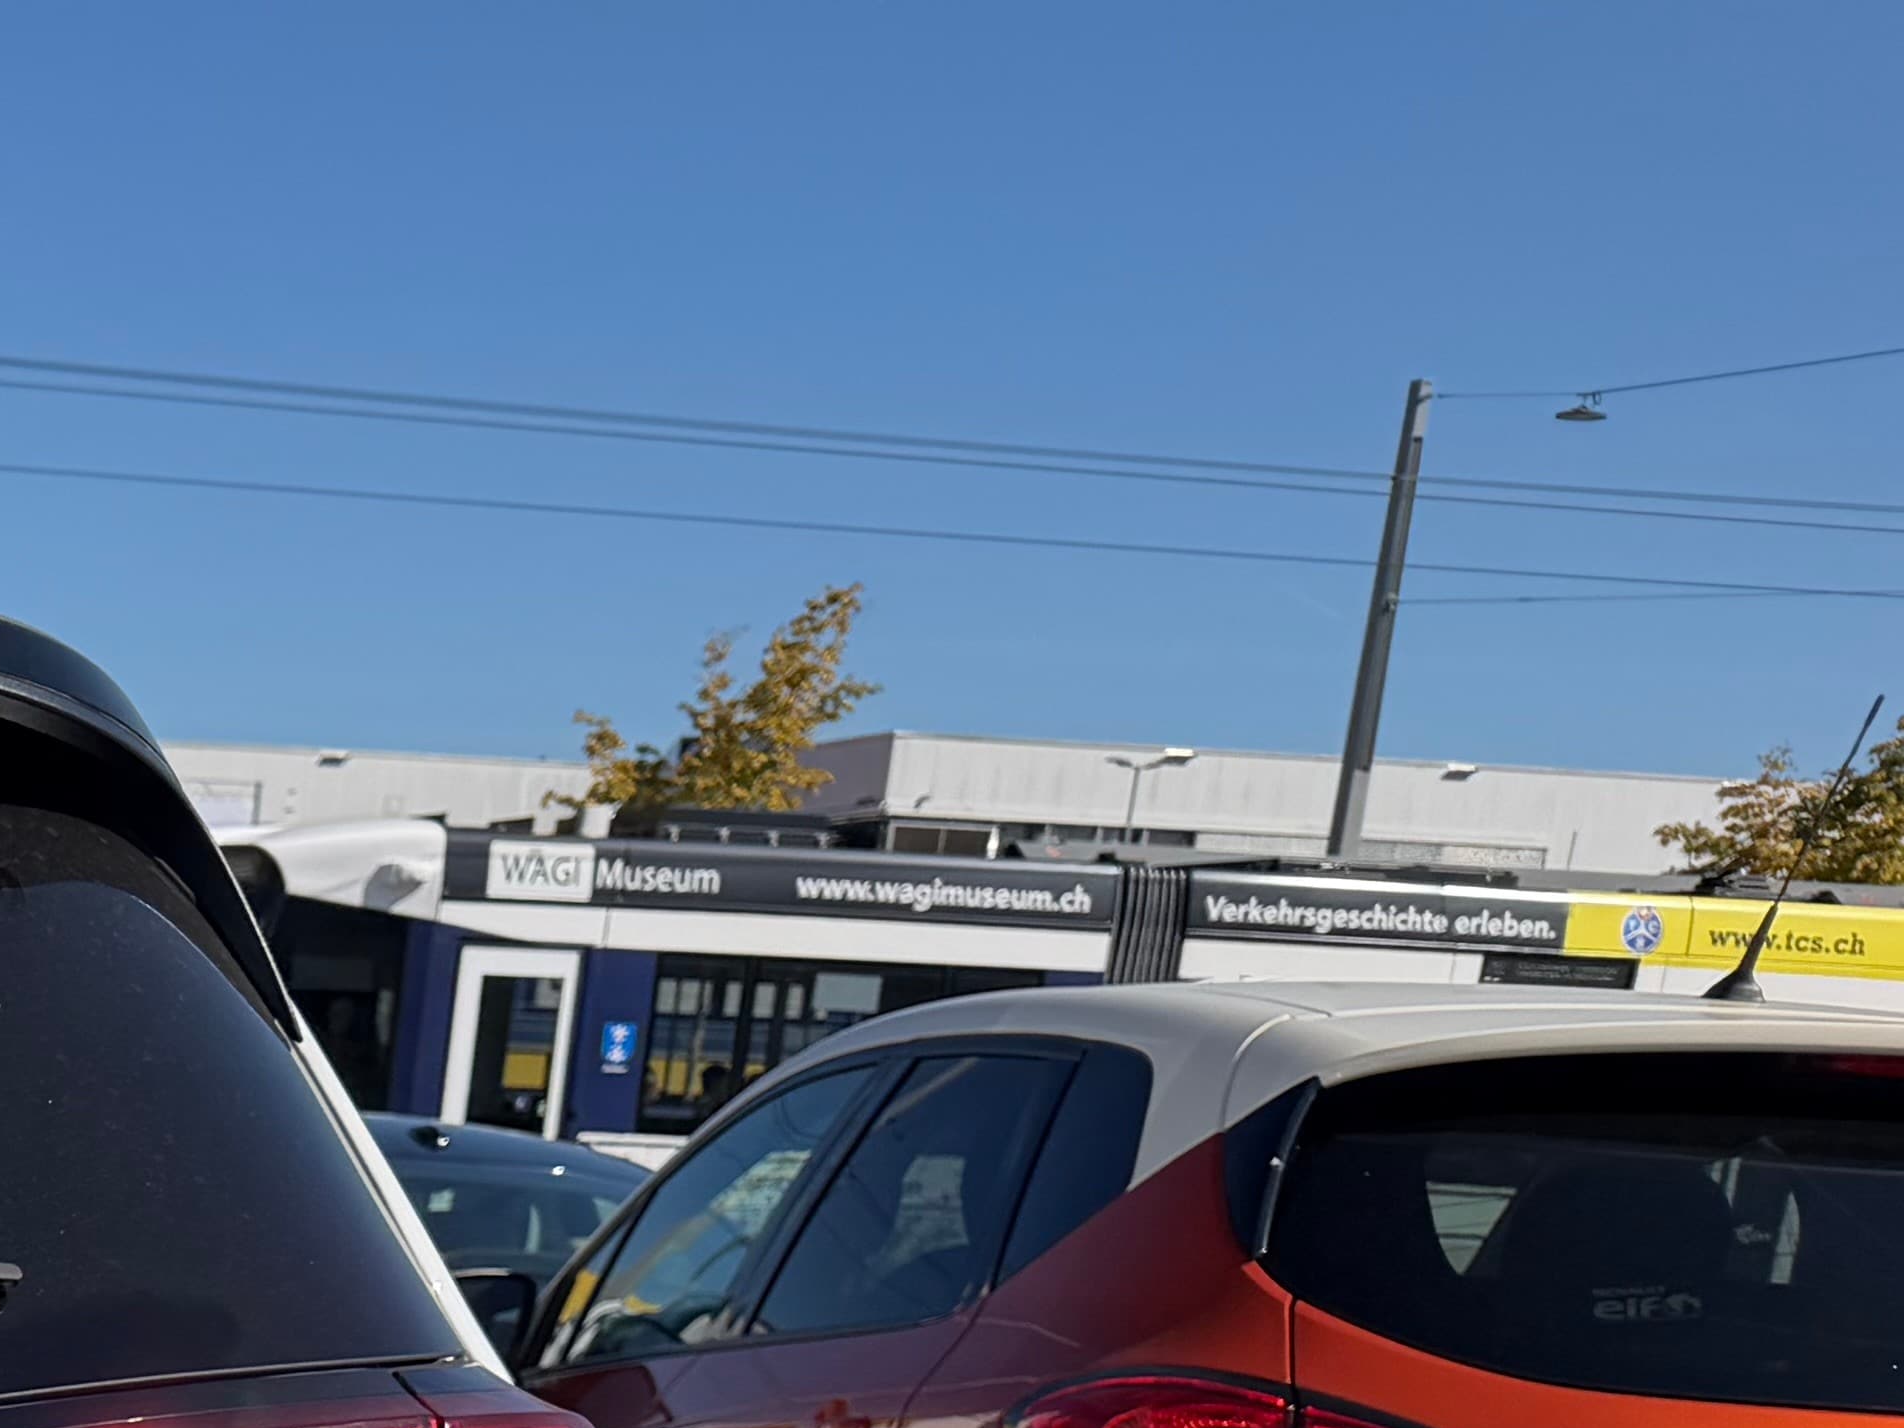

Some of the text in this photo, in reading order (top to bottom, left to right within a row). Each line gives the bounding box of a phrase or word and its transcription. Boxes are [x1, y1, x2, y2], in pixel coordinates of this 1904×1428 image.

[596, 858, 721, 894] Museum
[796, 876, 1091, 914] www.wagimuseum.ch
[1205, 895, 1558, 939] Verkehrsgeschichte erleben.
